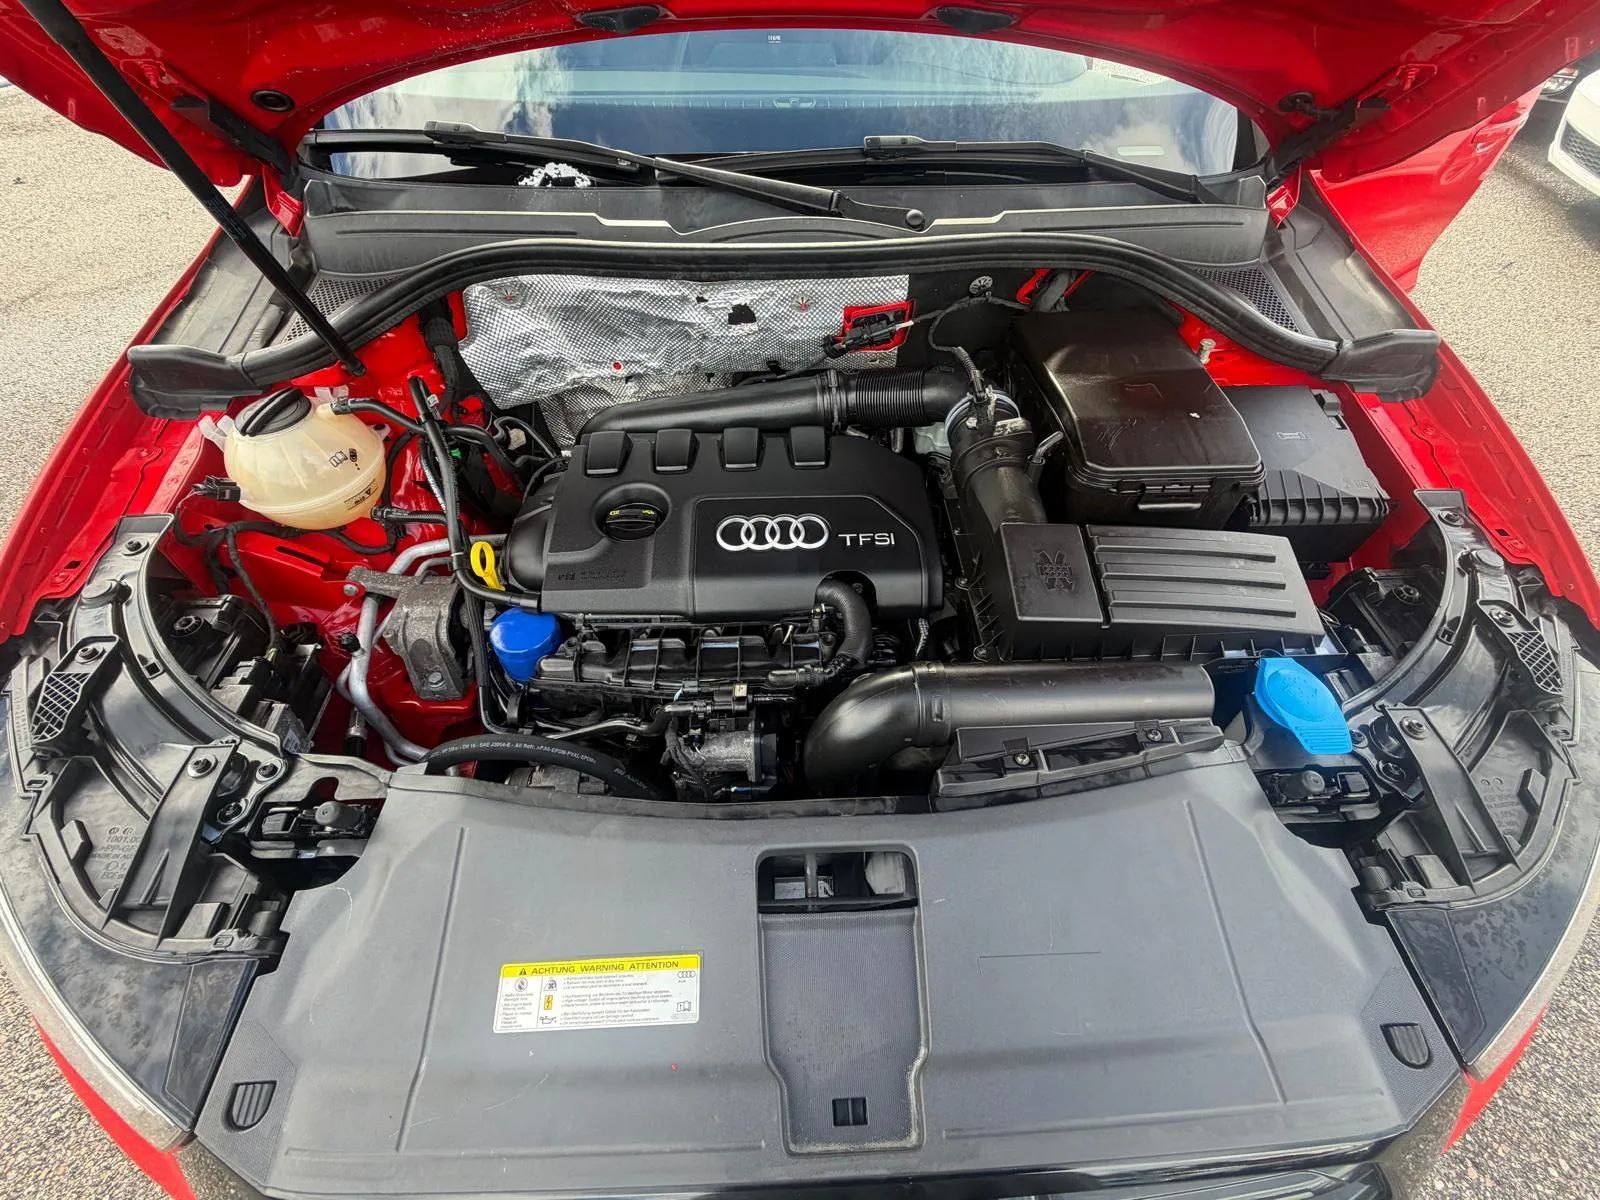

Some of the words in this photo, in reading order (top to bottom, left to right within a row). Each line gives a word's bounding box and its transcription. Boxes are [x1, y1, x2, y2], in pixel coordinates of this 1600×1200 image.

[838, 532, 896, 546] TFSI
[531, 965, 576, 975] ACHTUNG
[580, 963, 625, 973] WARNING
[628, 960, 679, 970] ATTENTION
